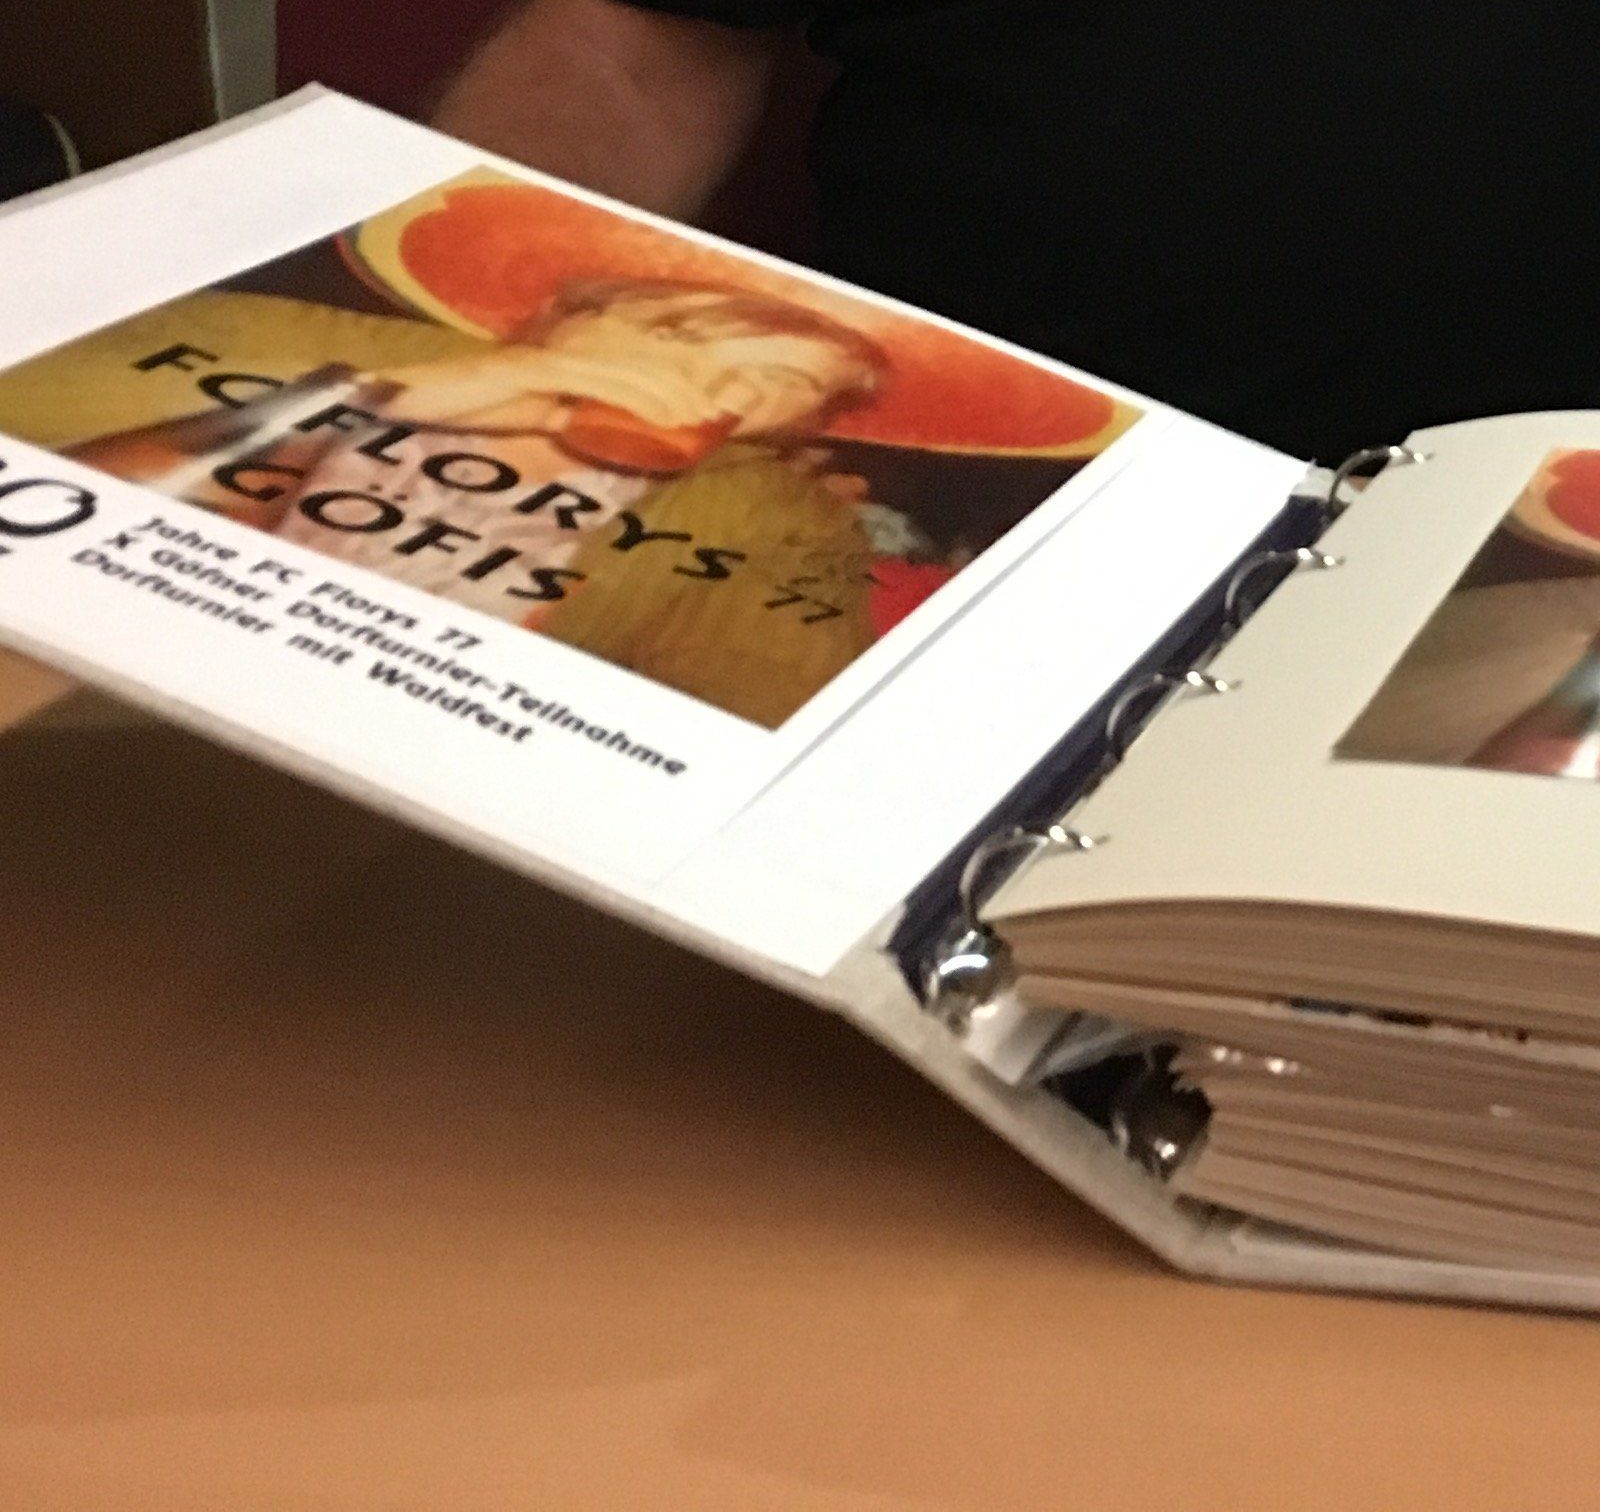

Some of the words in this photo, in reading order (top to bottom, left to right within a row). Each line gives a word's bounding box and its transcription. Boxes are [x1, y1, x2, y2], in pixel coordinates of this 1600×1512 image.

[132, 342, 284, 409] FC
[294, 403, 747, 579] FLORYS
[211, 461, 587, 601] GÖFIS
[69, 548, 276, 634] Dorfturnier
[286, 634, 354, 666] mit
[367, 660, 533, 743] Waldfest
[131, 516, 240, 561] Jahre
[249, 559, 304, 584] FC
[308, 581, 419, 630] Florys
[434, 627, 482, 650] 77
[285, 600, 688, 776] Dorfturnier-Teilnahme
